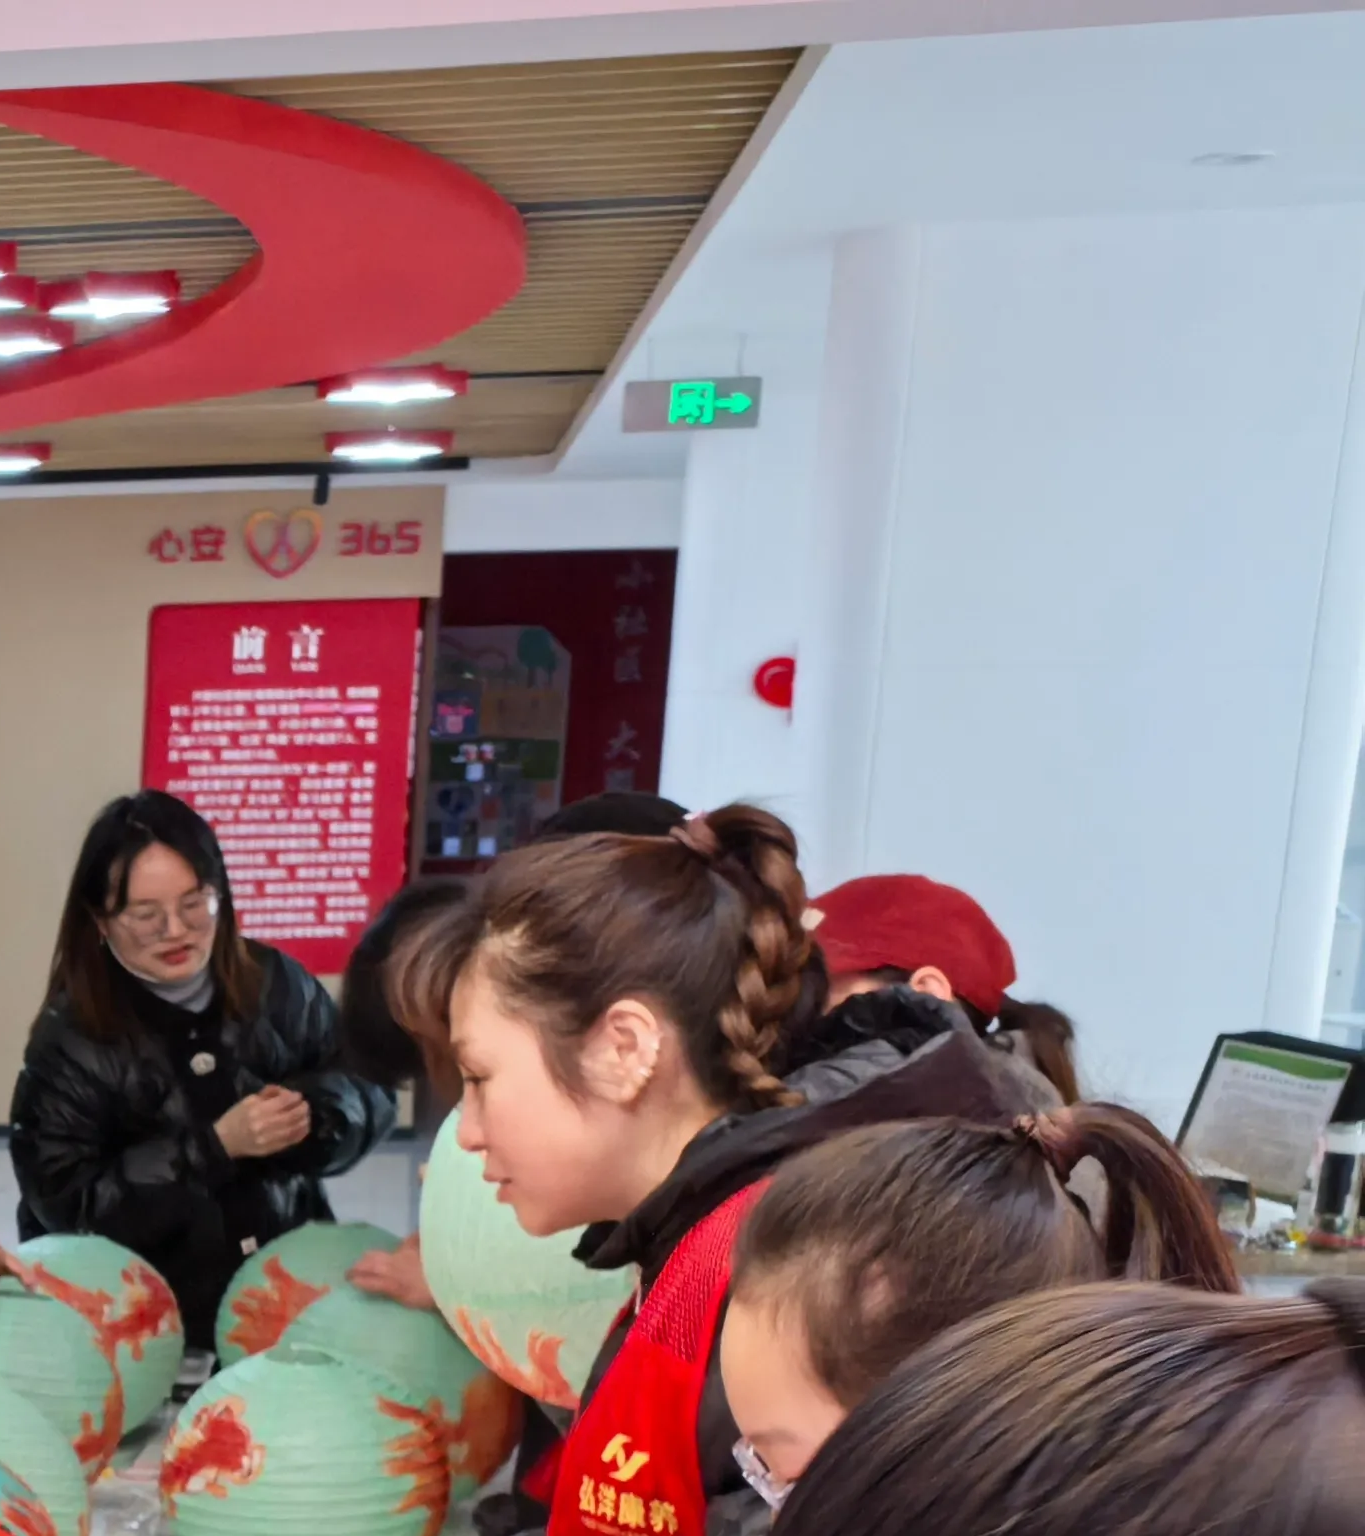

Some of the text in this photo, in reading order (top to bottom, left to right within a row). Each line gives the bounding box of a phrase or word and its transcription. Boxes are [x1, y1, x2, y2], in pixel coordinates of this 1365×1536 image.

[147, 521, 422, 563] 心安 365
[232, 623, 325, 660] 前言
